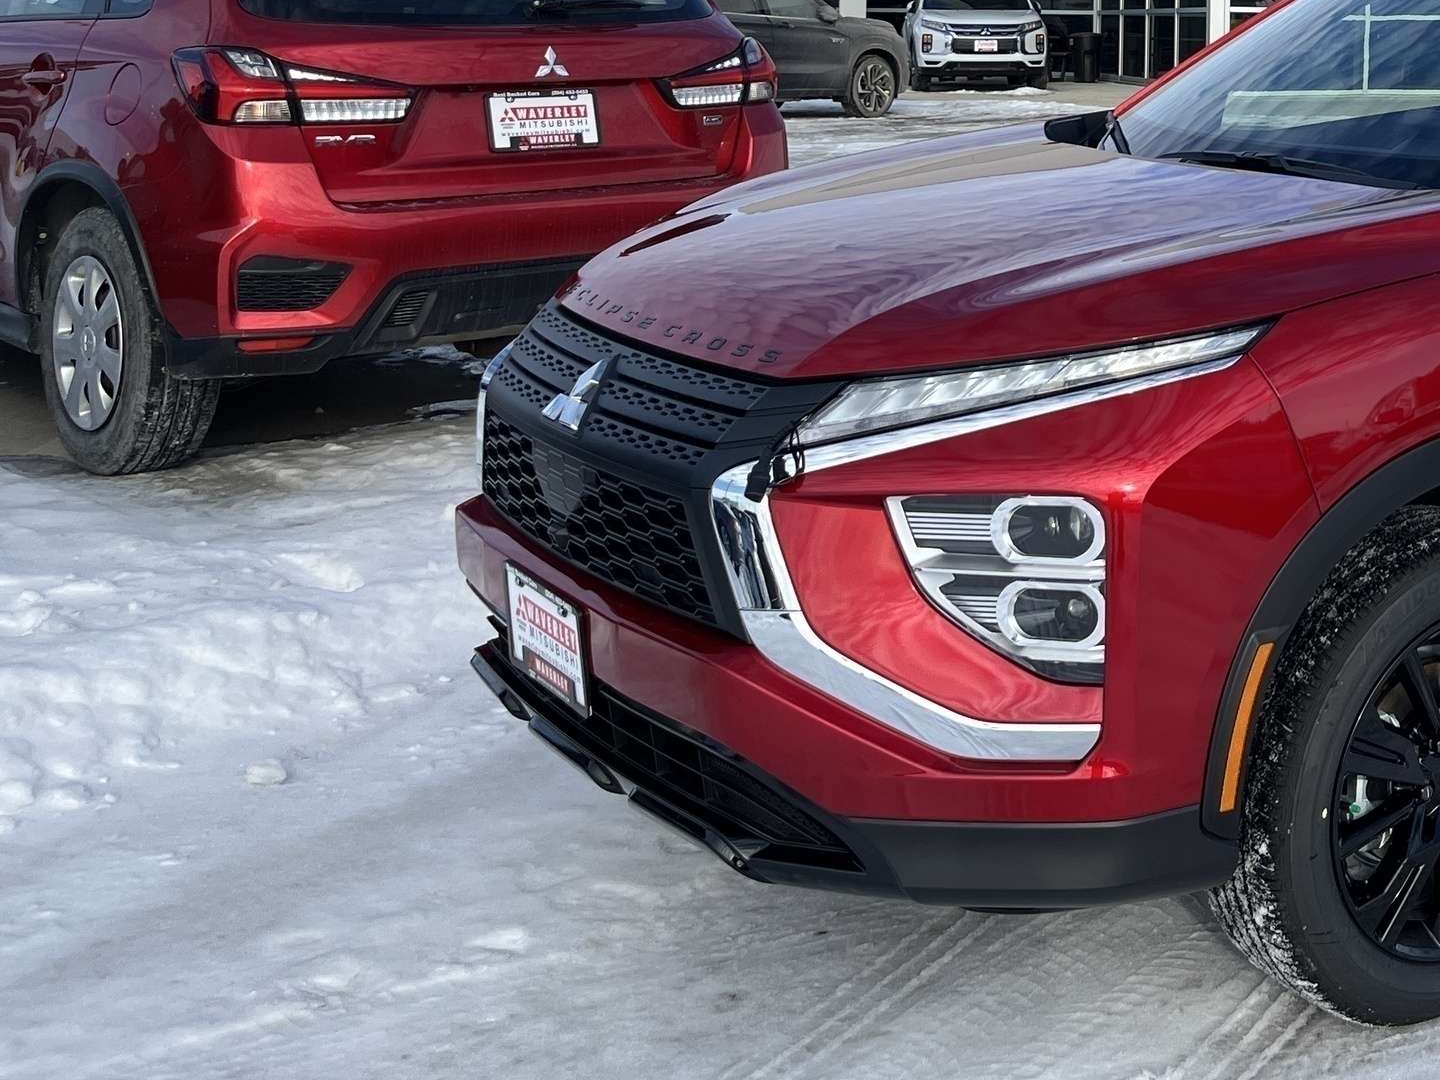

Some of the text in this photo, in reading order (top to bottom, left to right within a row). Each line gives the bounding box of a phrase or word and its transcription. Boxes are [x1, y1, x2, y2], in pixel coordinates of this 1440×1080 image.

[515, 106, 586, 119] WAVERLEY
[519, 119, 588, 129] MITSUBISHI
[529, 134, 576, 144] WAVERLEY
[566, 283, 657, 330] ECLIPSE
[663, 324, 783, 364] CROSS
[526, 601, 577, 651] WAVERLEY
